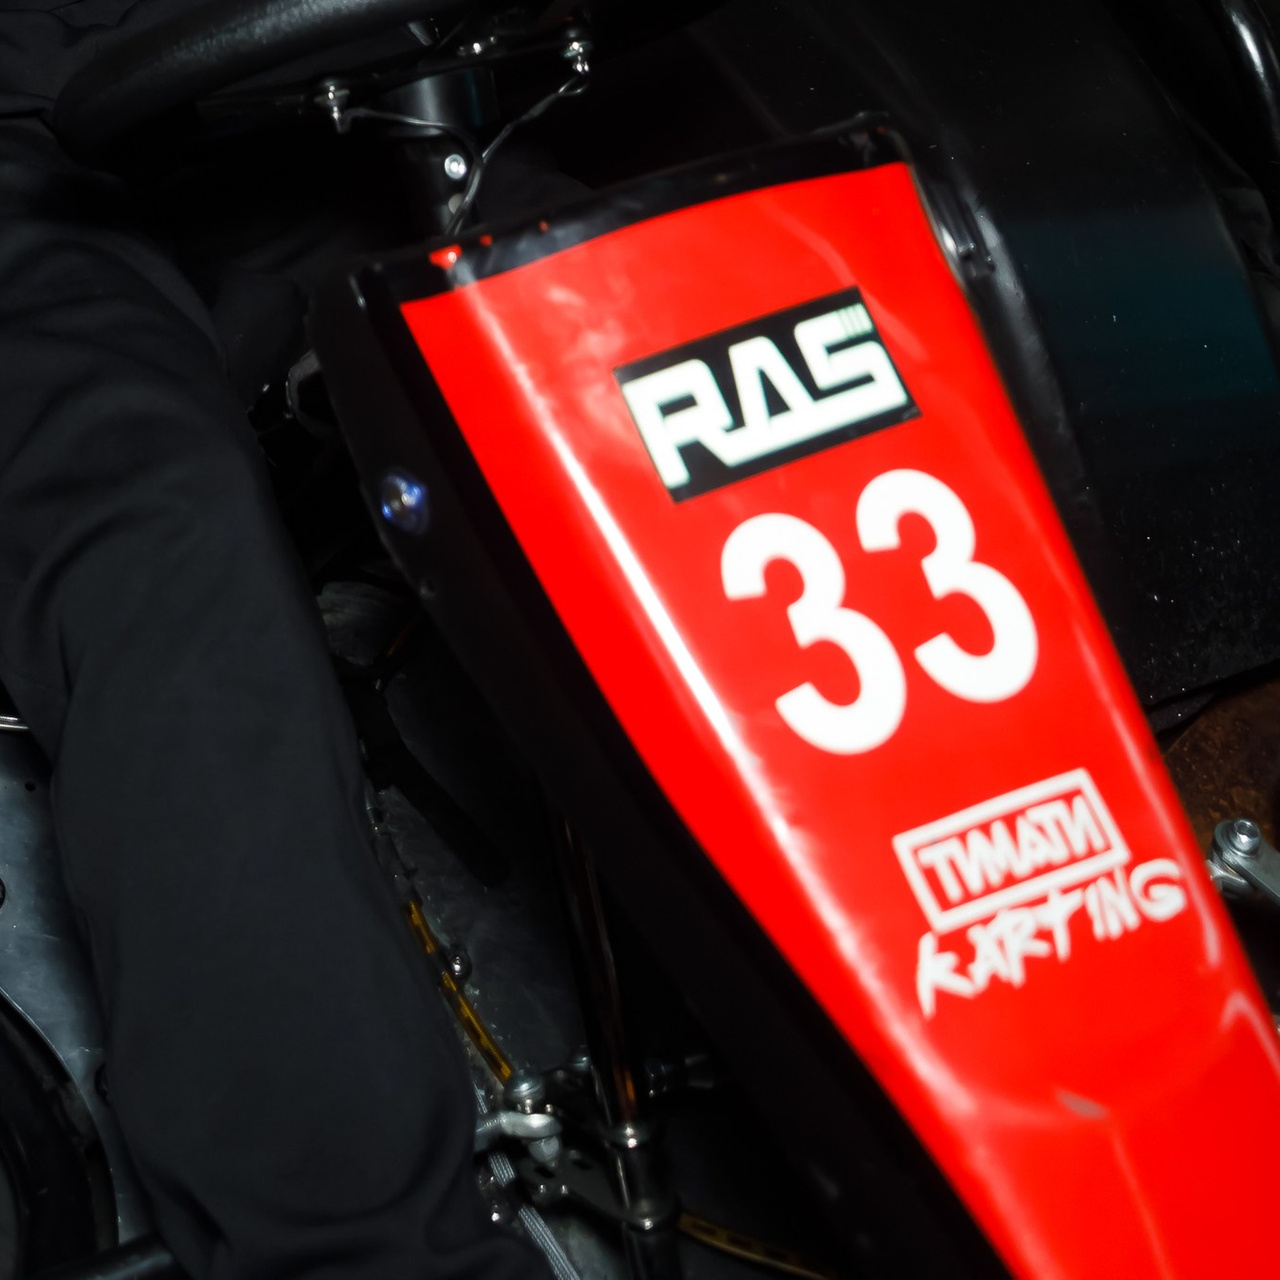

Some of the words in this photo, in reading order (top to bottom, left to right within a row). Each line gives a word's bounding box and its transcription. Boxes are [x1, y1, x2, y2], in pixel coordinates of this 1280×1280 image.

[621, 302, 909, 489] RAS
[720, 467, 1039, 756] 33
[915, 856, 1187, 1022] KARTING
